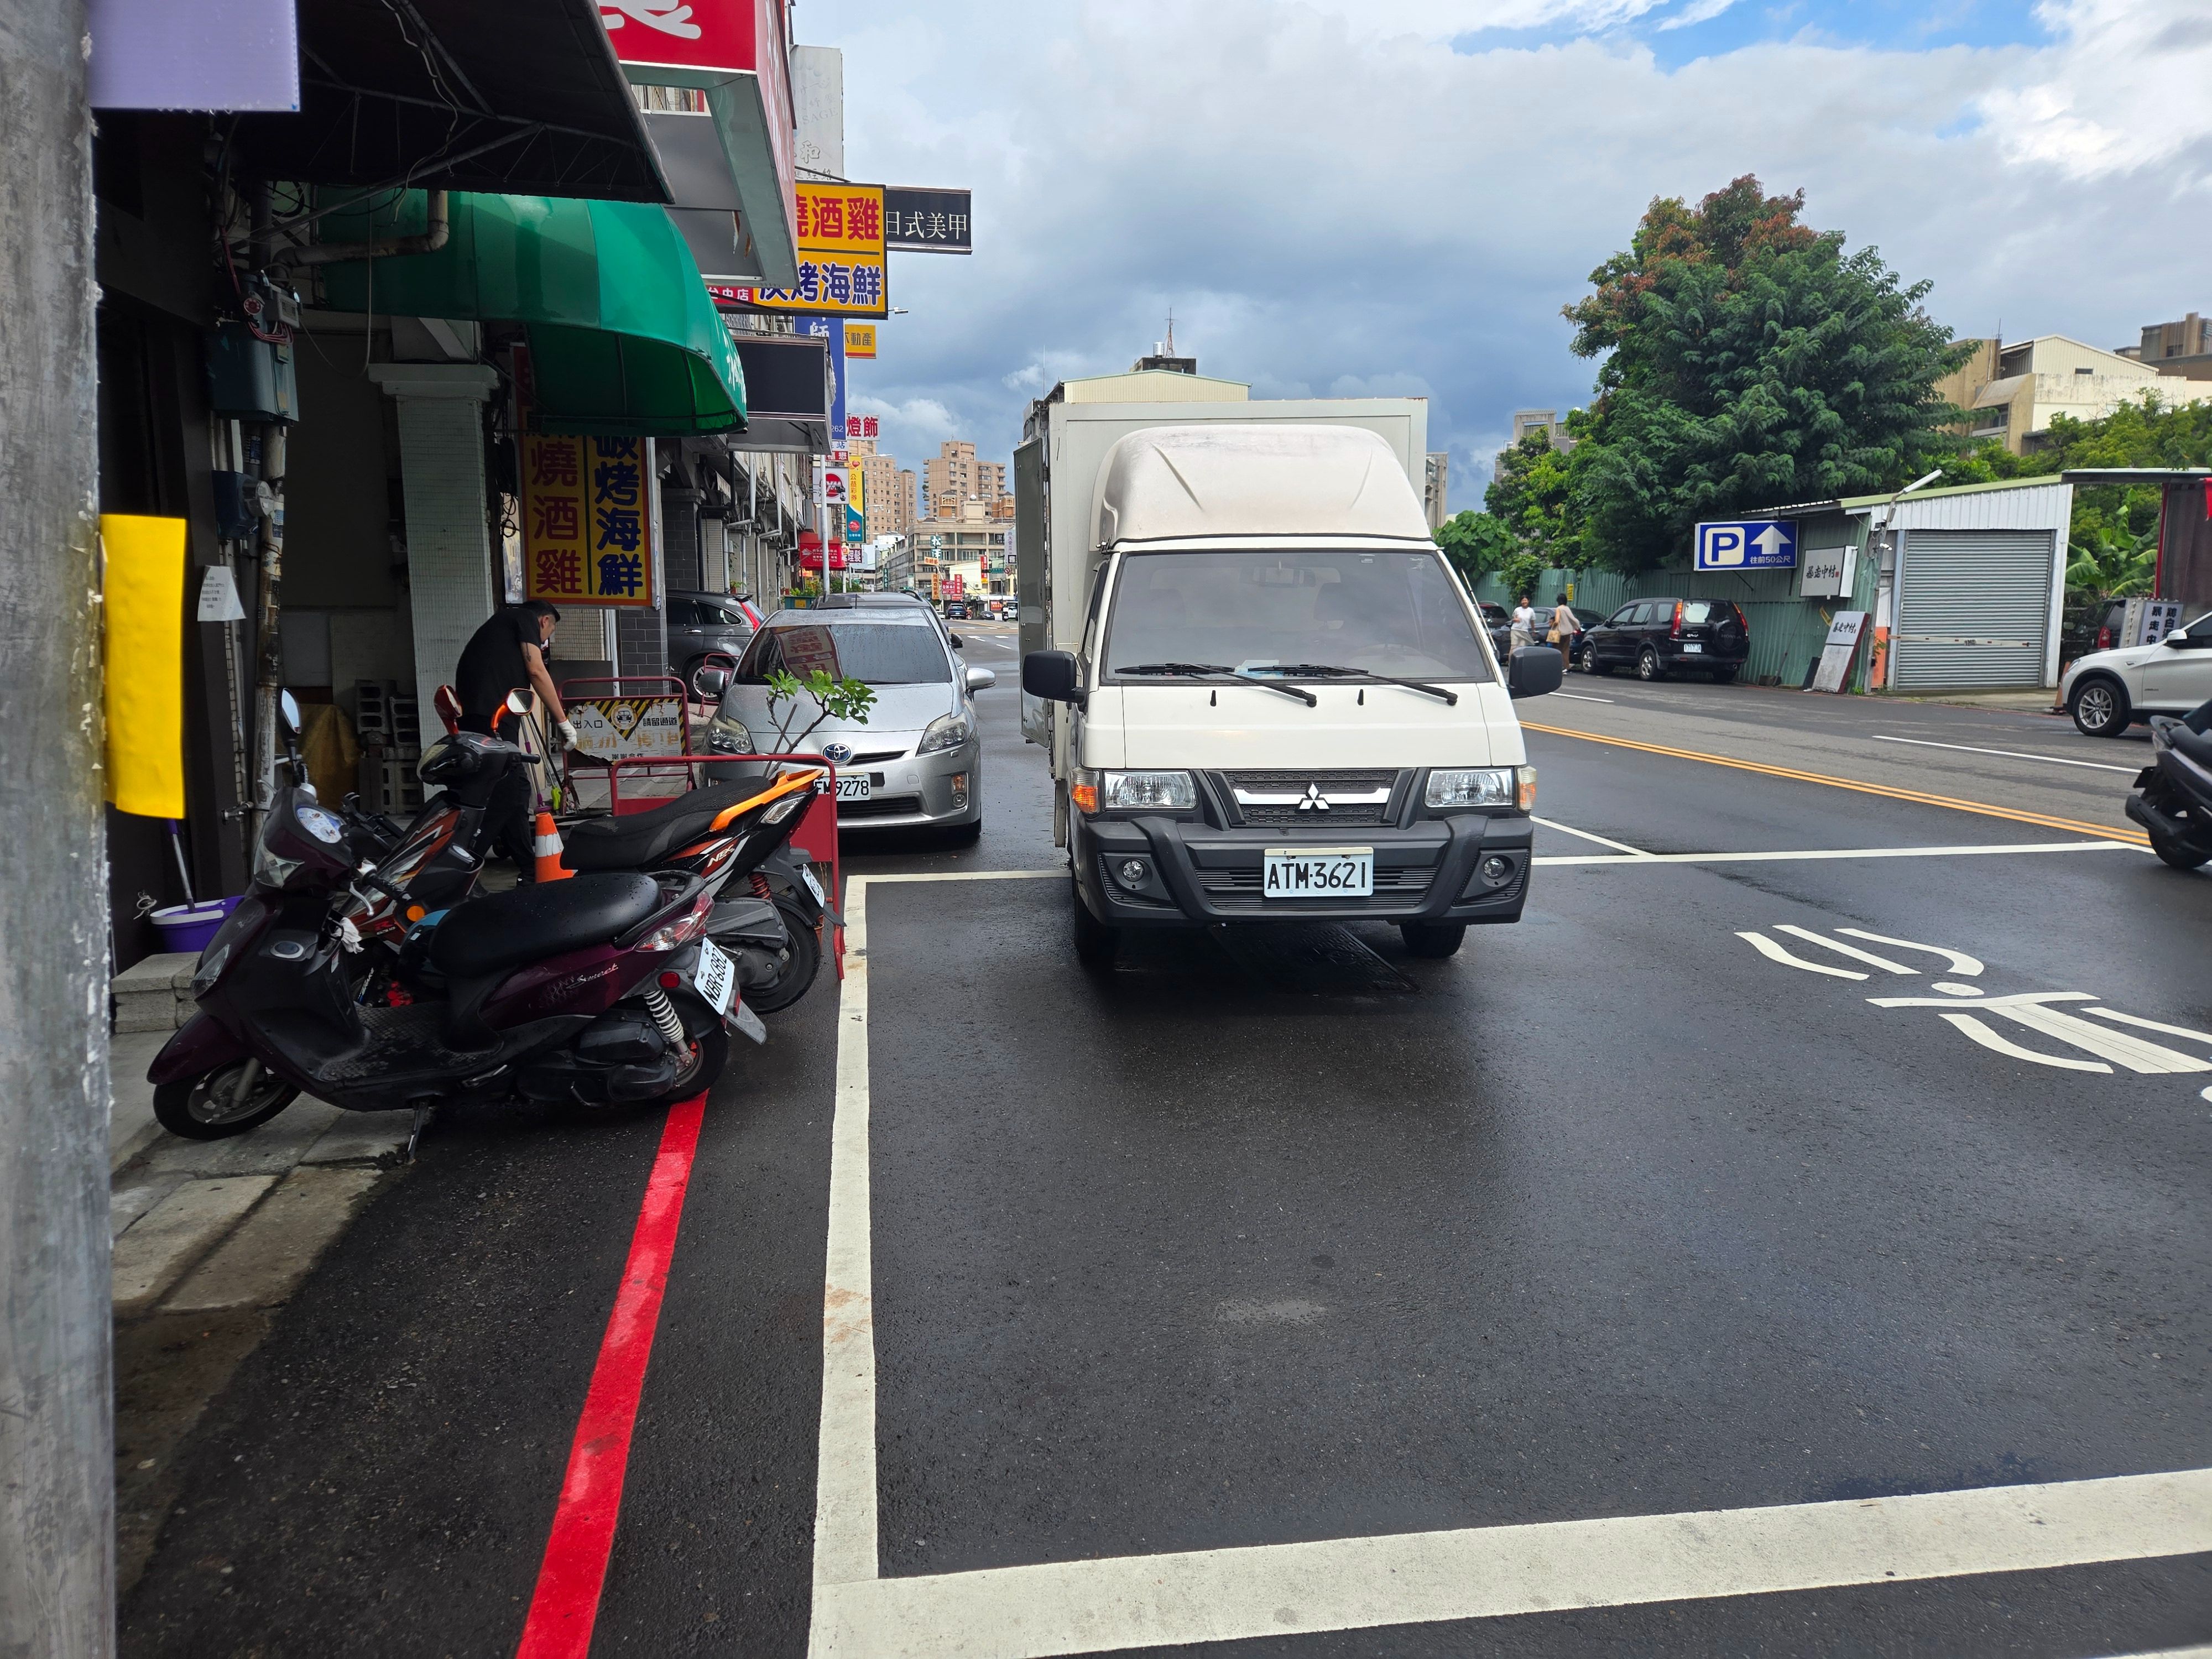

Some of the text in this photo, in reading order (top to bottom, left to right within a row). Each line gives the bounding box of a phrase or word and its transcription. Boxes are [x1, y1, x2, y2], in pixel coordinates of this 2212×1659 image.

[886, 210, 967, 239] 日式美甲
[759, 262, 881, 305] 烤海鮮
[847, 416, 878, 437] 燈飾
[531, 441, 582, 595] 燒酒雞
[1712, 533, 1740, 562] P
[1750, 555, 1791, 564] 往前50公尺
[573, 719, 603, 729] 出入口
[643, 717, 678, 727] 請留通道
